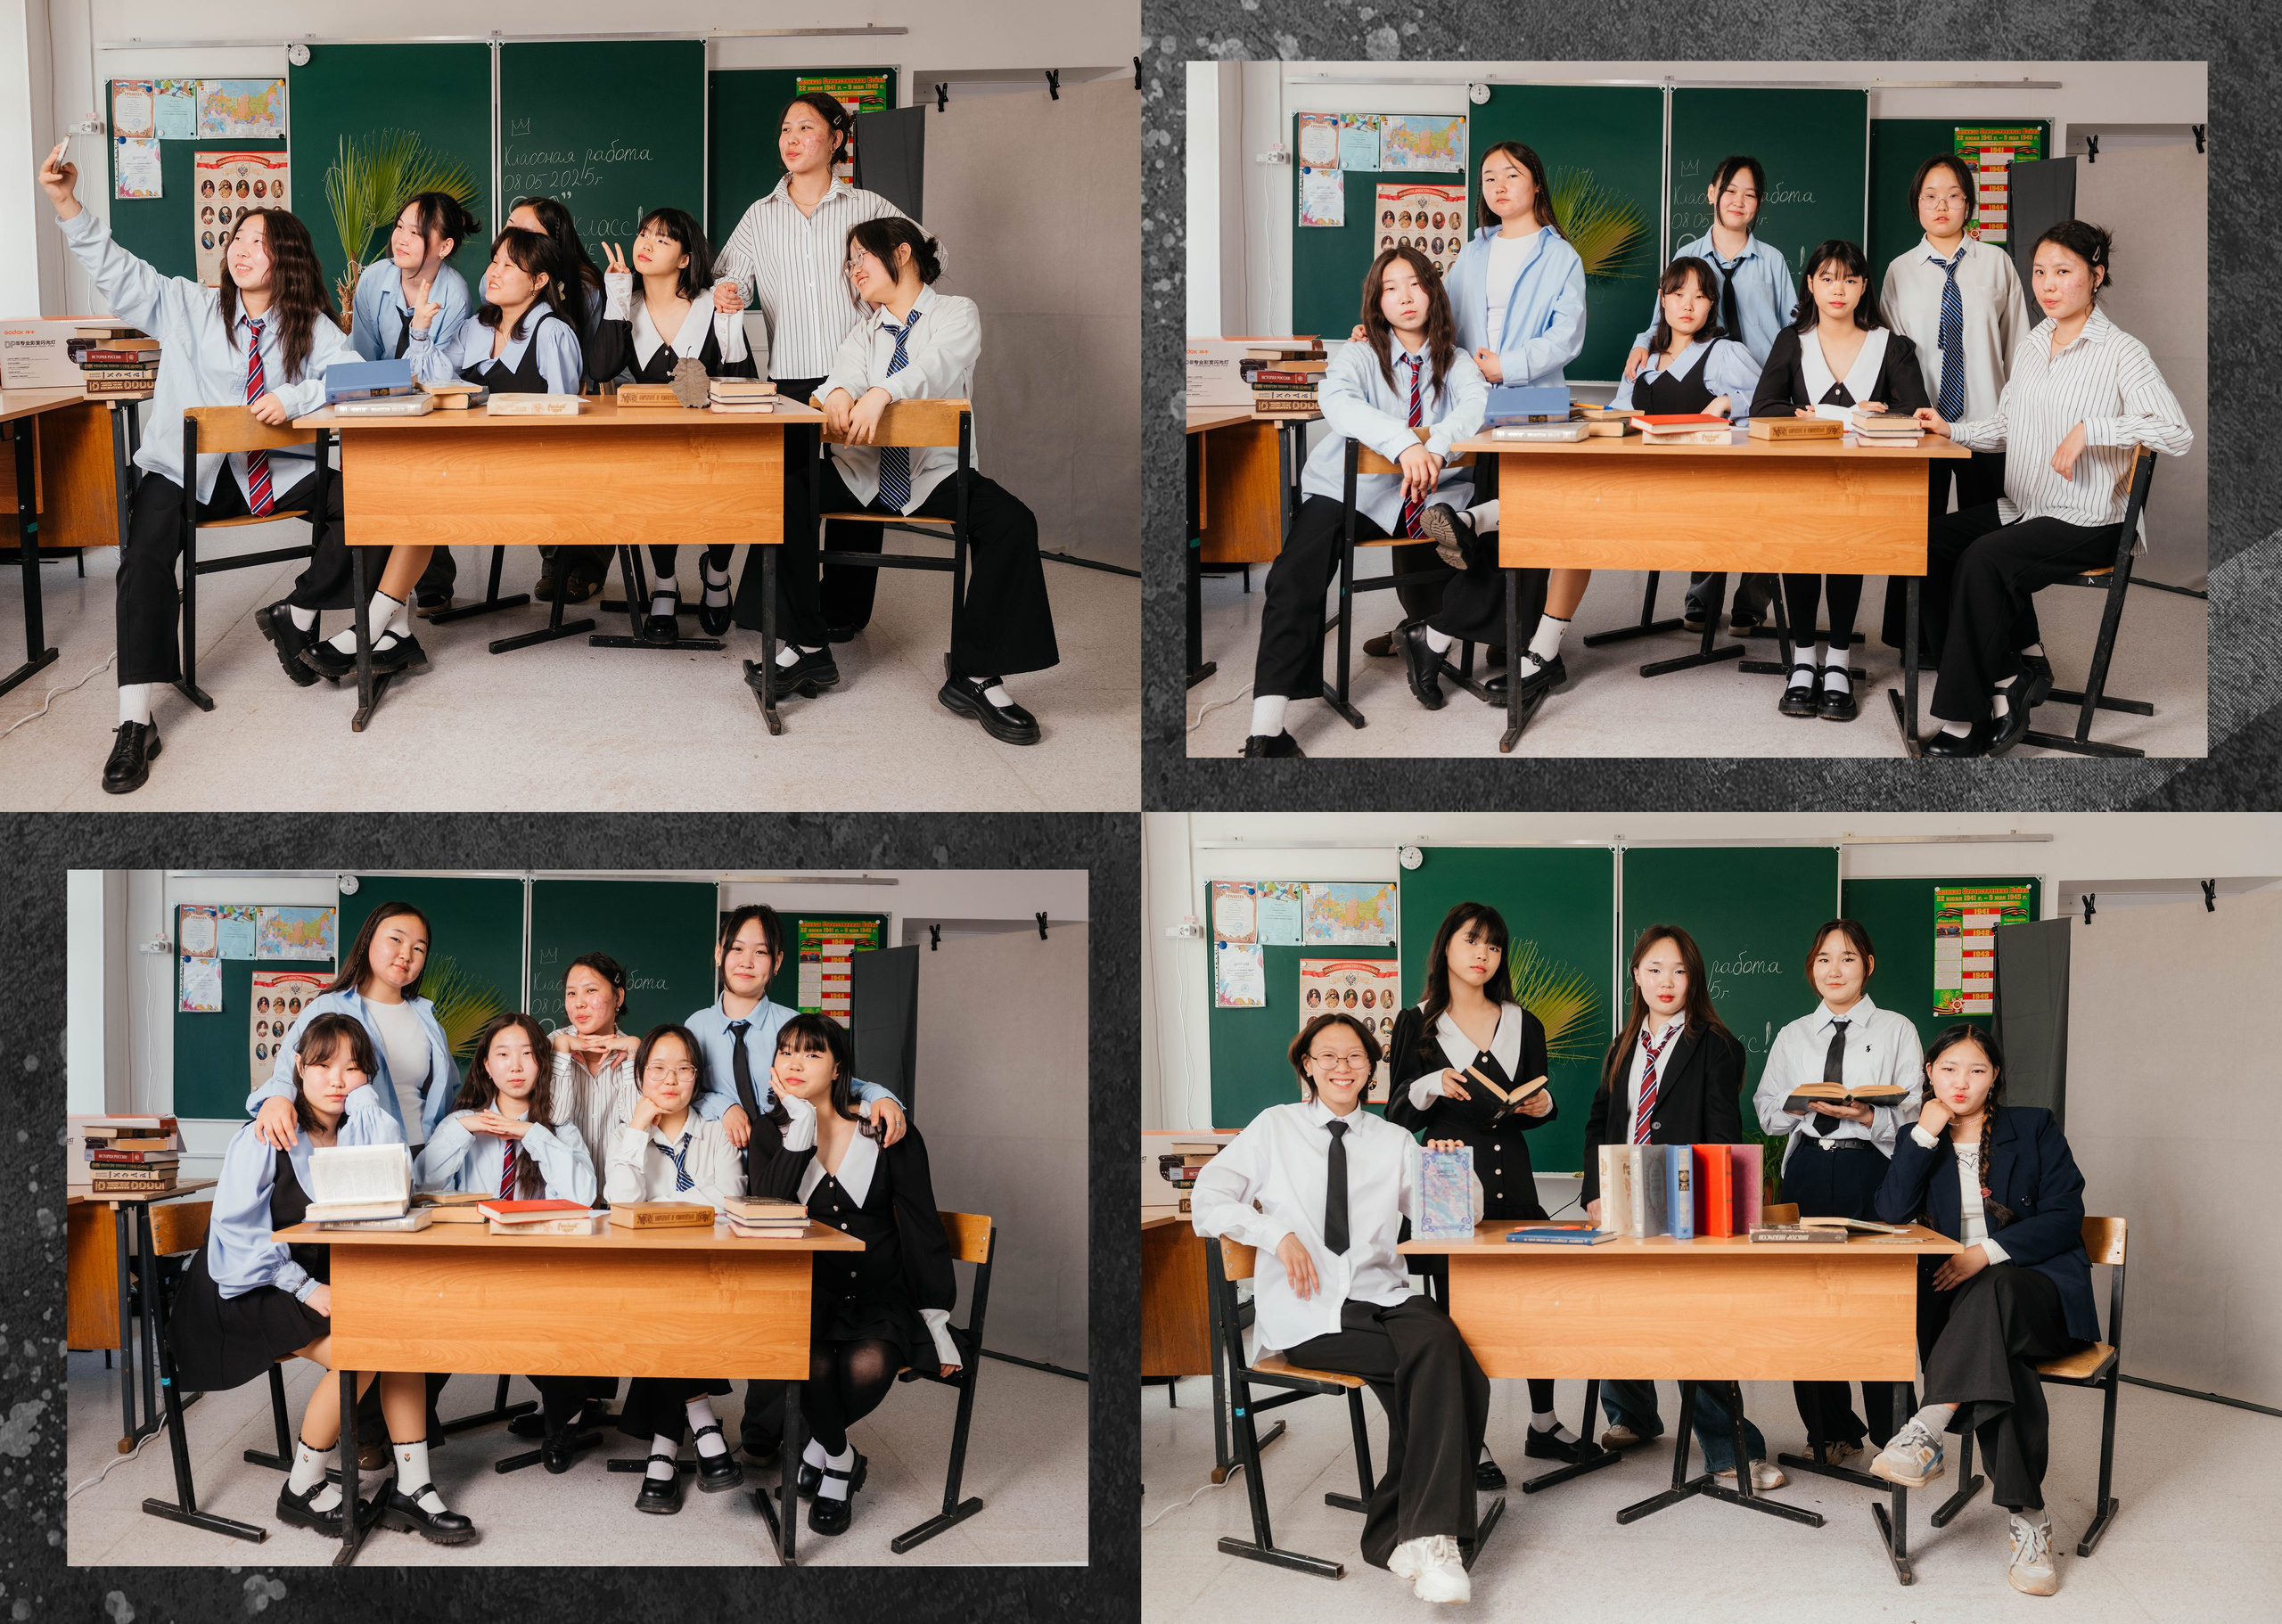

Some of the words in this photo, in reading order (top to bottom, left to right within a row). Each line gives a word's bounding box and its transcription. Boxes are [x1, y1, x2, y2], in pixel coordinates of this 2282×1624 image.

[505, 144, 576, 167] Классная
[581, 139, 653, 179] работа
[1674, 185, 1709, 205] Класс
[1761, 182, 1817, 204] абота
[626, 970, 669, 991] бота
[1706, 950, 1783, 991] работа
